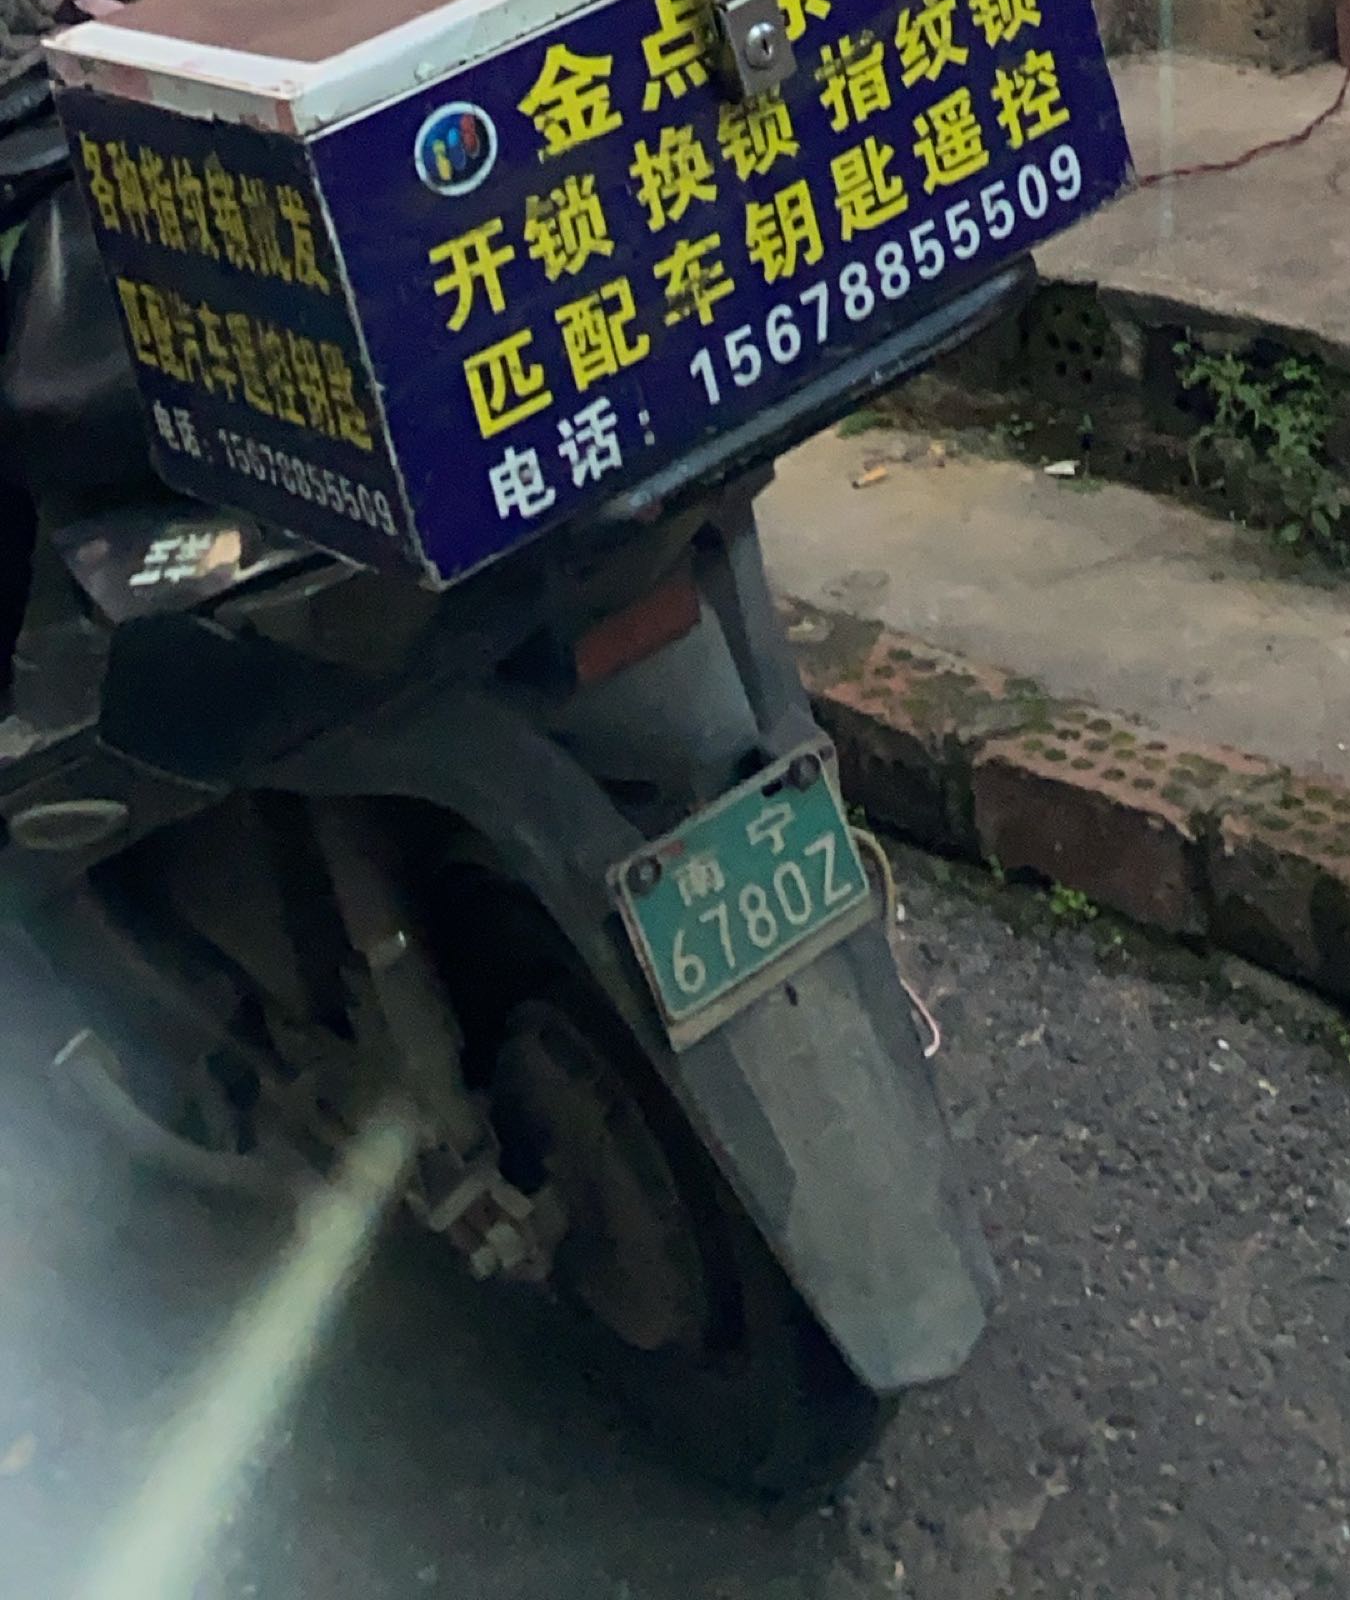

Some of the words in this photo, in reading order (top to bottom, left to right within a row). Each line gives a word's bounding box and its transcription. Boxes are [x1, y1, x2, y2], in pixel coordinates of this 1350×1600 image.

[78, 129, 332, 297] 各种指纹锁批发
[462, 48, 1073, 441] 匹配车钥匙遥控
[688, 143, 1085, 408] 15678855509
[115, 274, 375, 453] 匹配汽车遥控钥匙
[217, 426, 400, 538] 15678855509
[671, 801, 797, 907] 南宁
